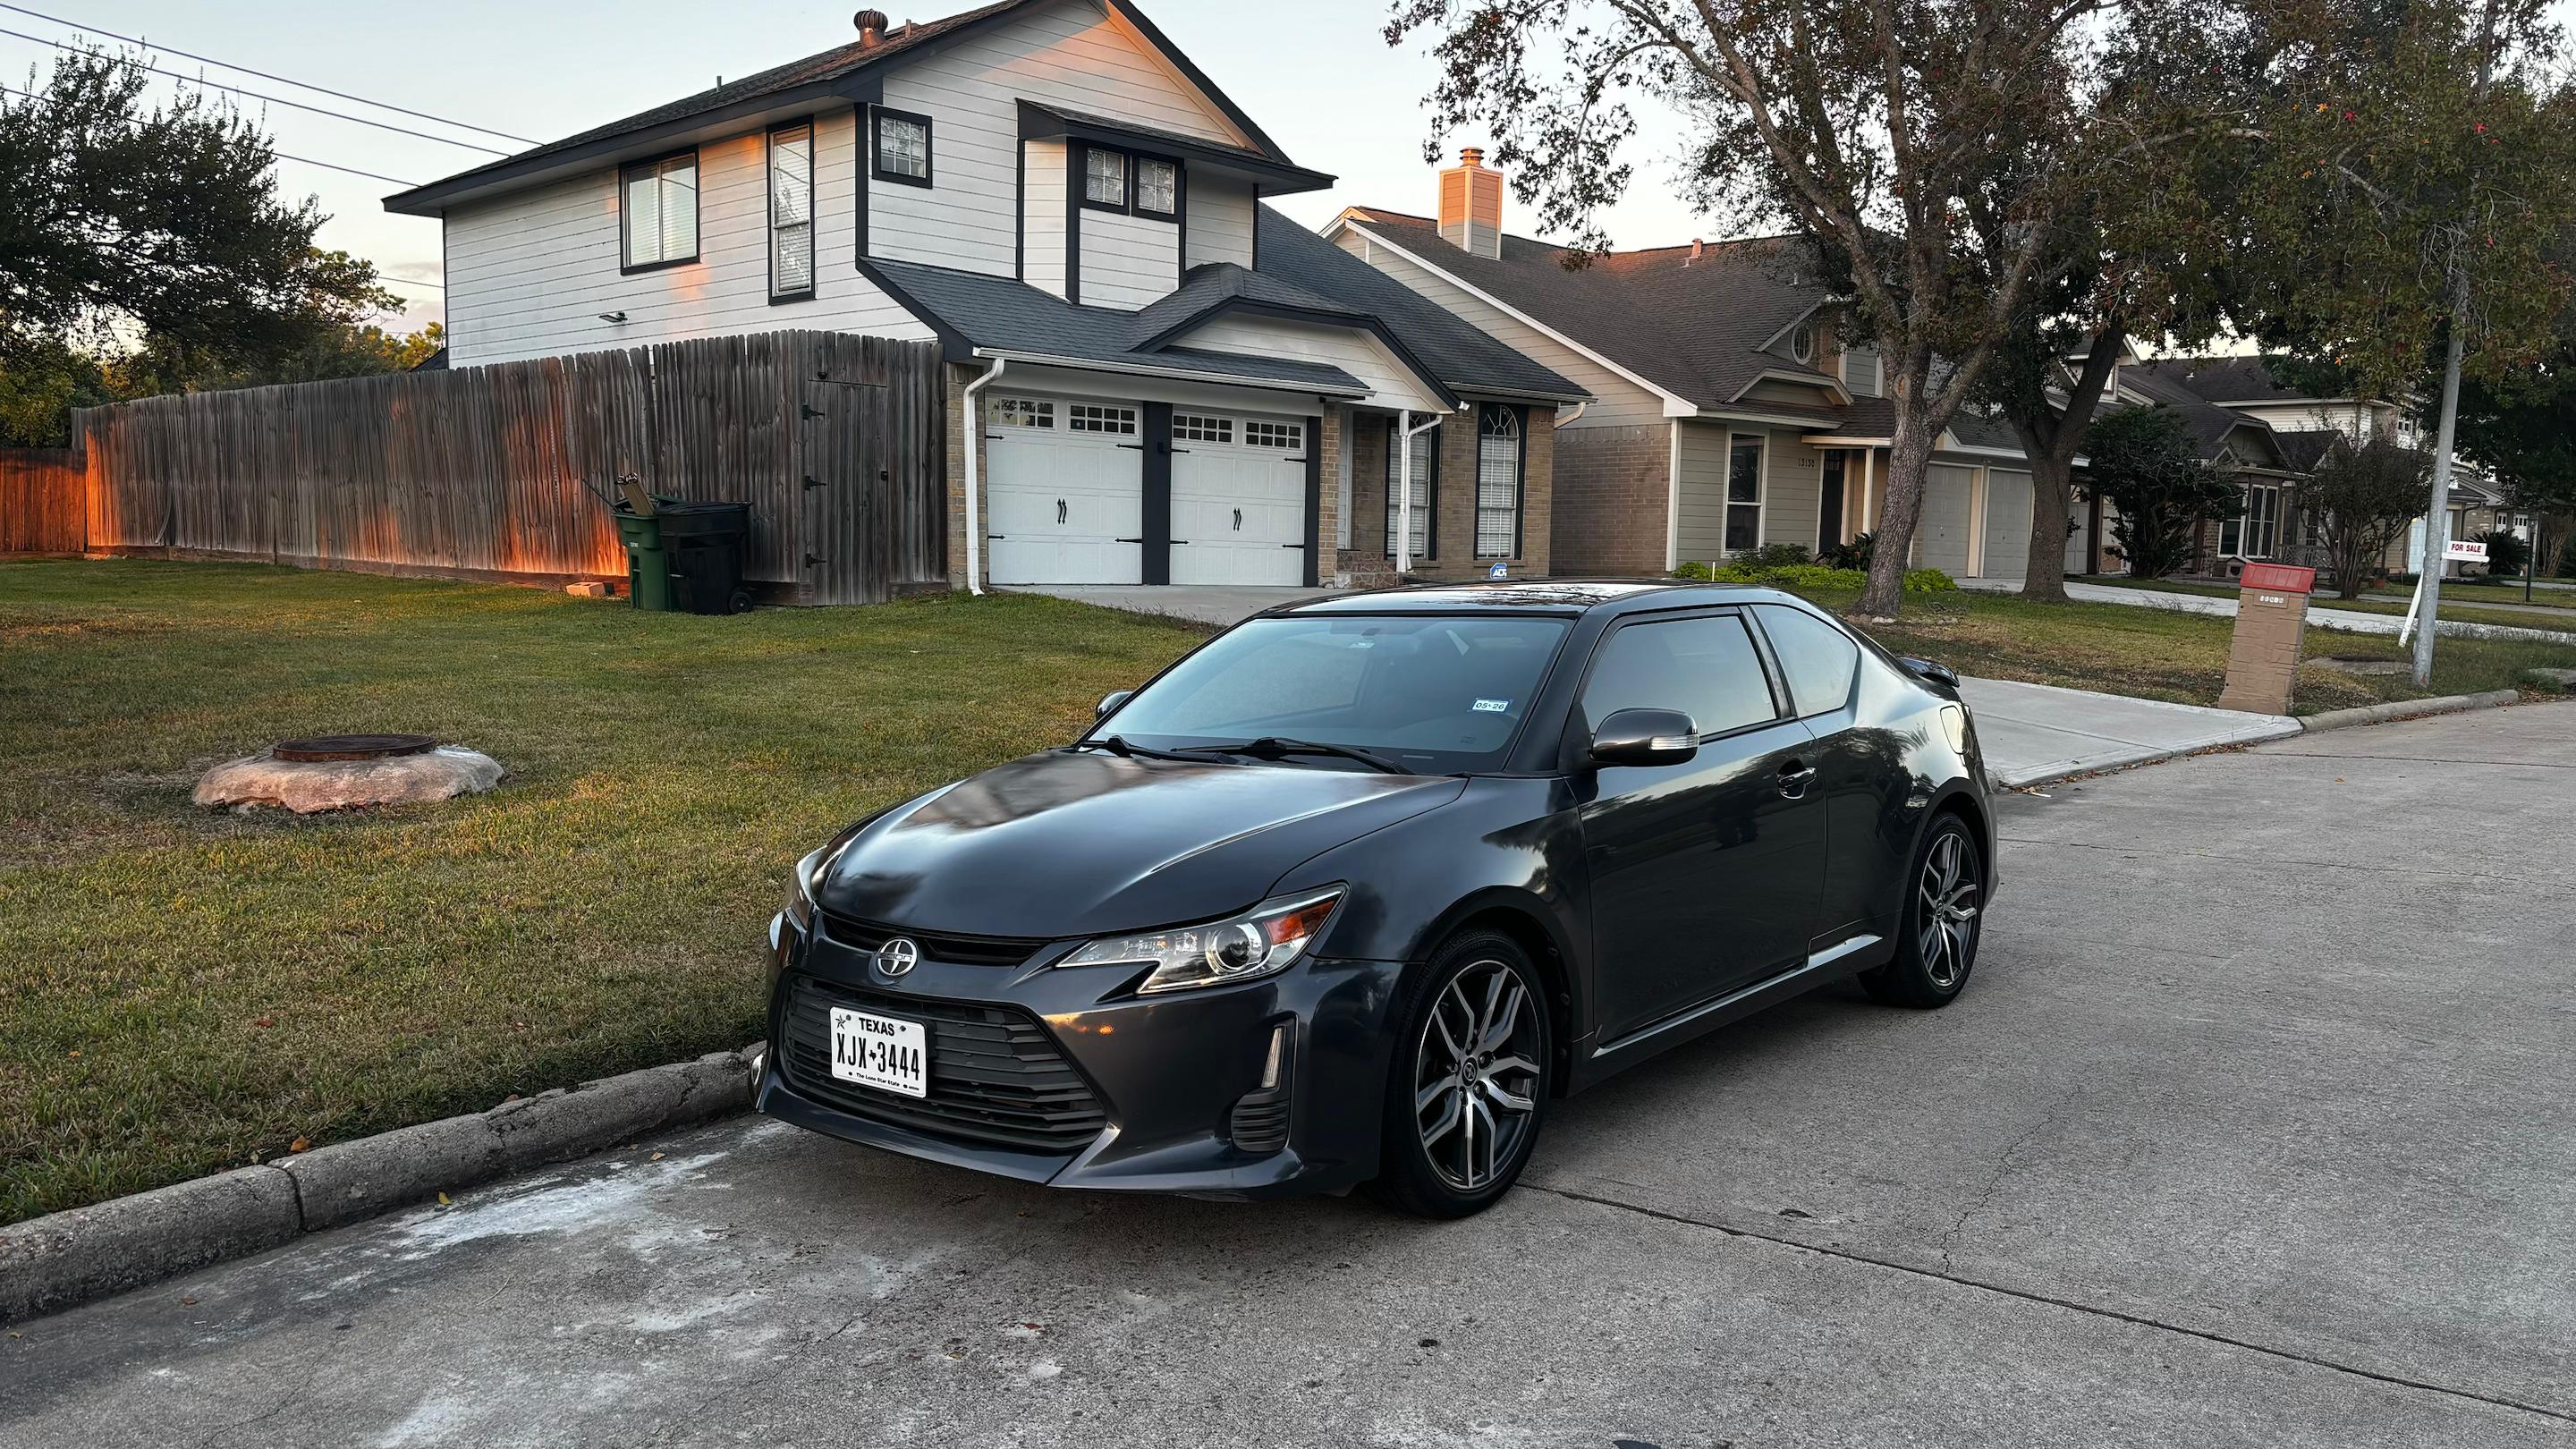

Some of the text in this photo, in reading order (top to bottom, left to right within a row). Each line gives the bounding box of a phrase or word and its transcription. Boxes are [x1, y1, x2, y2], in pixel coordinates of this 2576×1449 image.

[2451, 543, 2482, 553] FOR SALE
[859, 1017, 895, 1037] TEXAS
